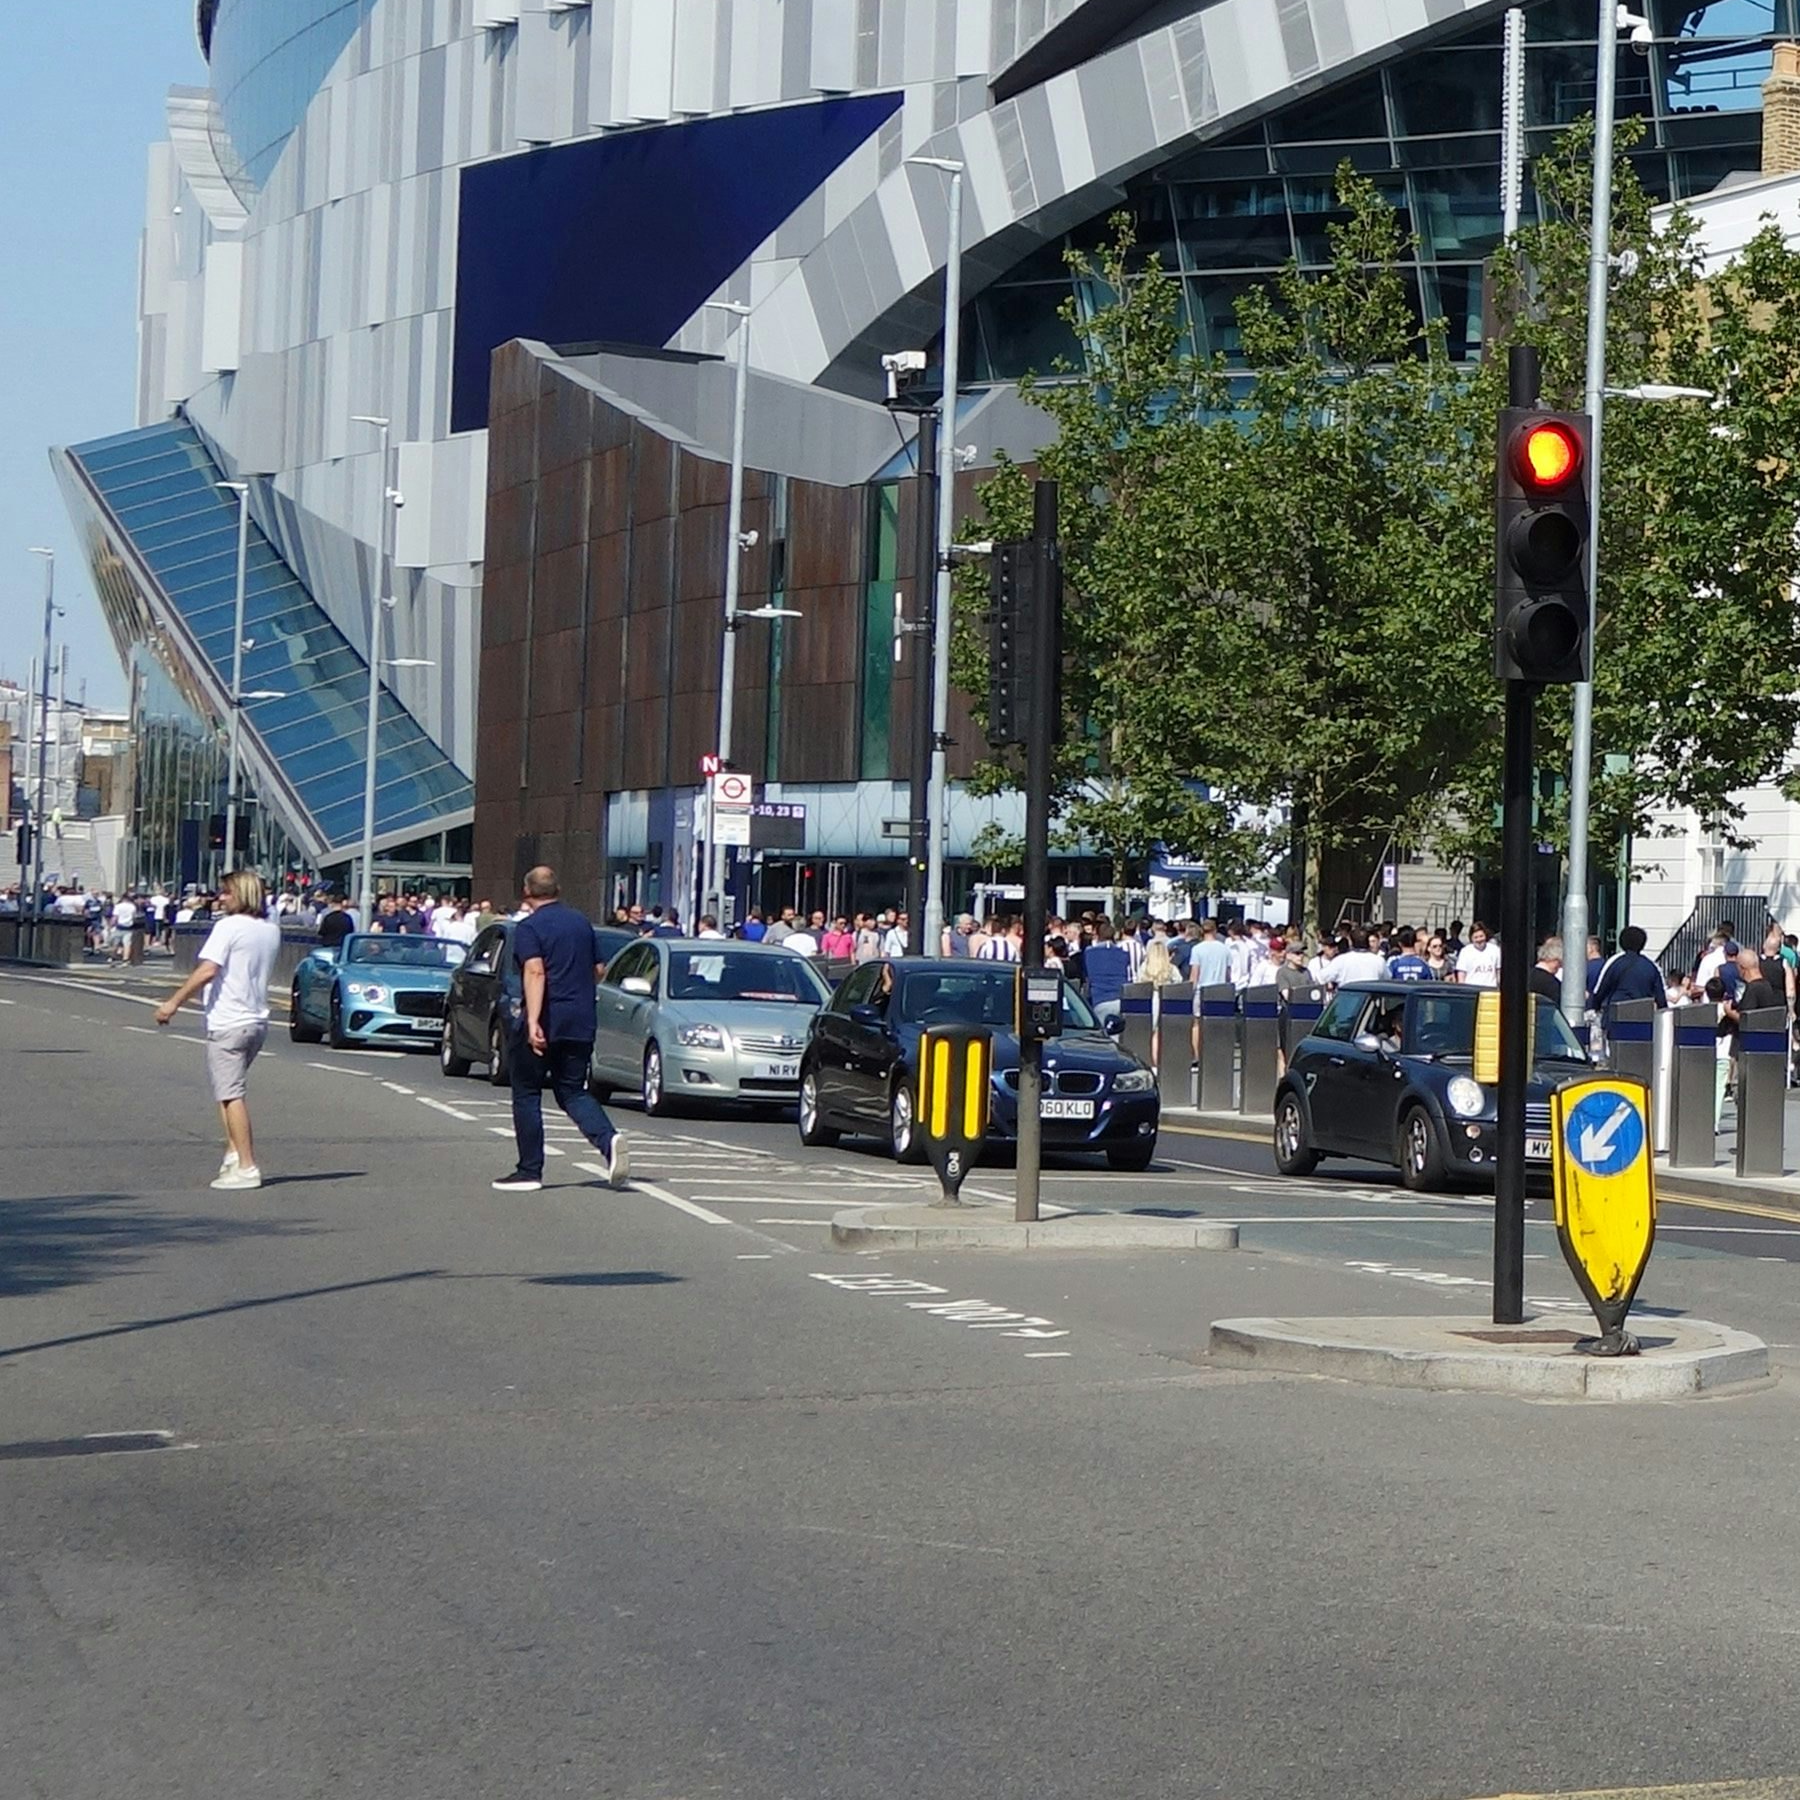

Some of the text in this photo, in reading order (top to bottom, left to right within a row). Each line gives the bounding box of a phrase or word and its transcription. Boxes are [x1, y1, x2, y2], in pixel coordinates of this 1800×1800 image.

[703, 756, 719, 773] N
[776, 806, 791, 817] 23
[1066, 1103, 1092, 1116] KLO
